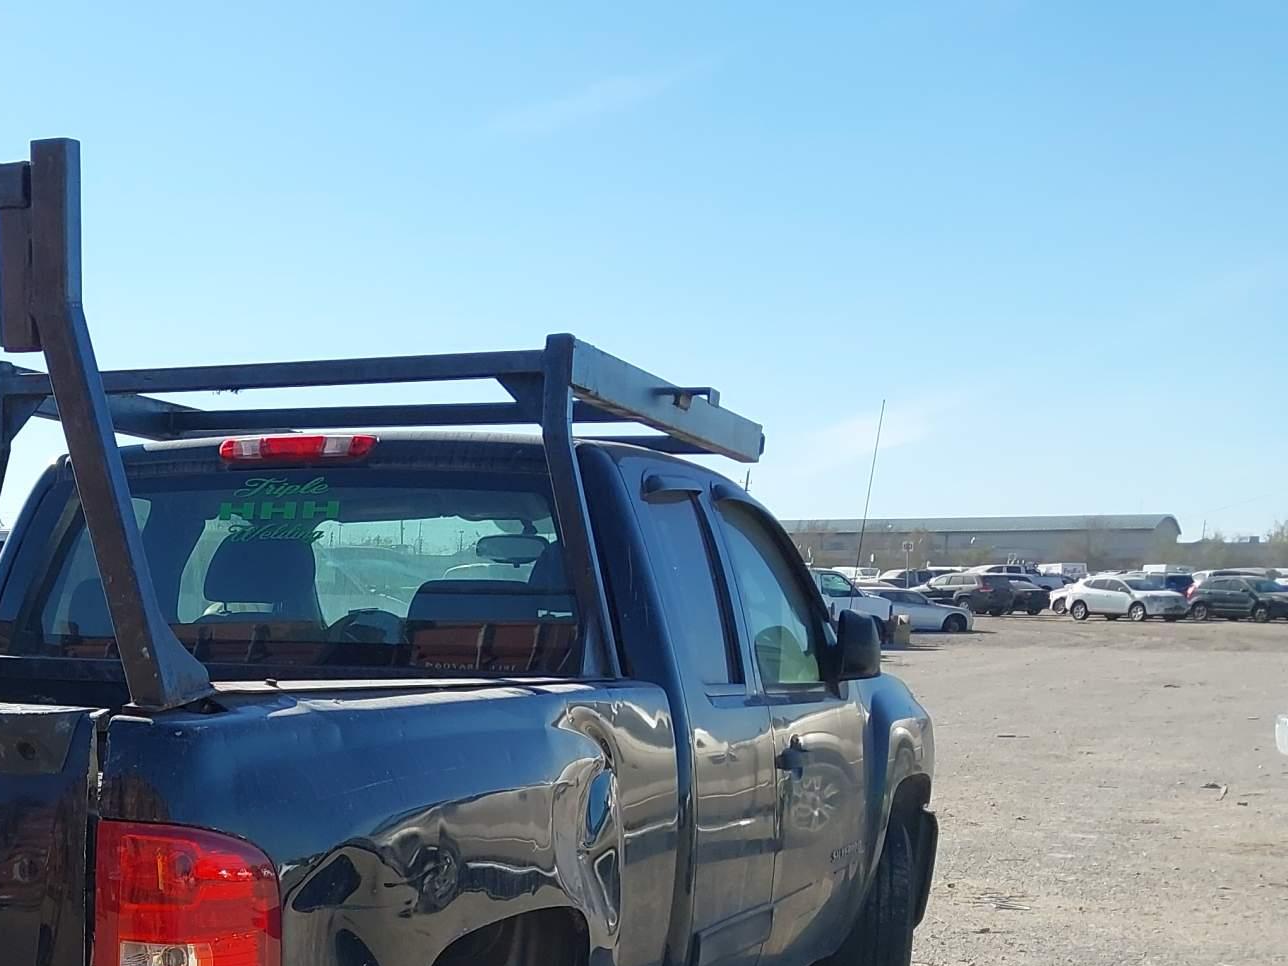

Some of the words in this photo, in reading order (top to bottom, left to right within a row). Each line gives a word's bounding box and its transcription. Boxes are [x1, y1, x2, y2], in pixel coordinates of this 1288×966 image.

[233, 476, 329, 498] Triple
[219, 500, 341, 520] HHH
[228, 522, 325, 544] Welding
